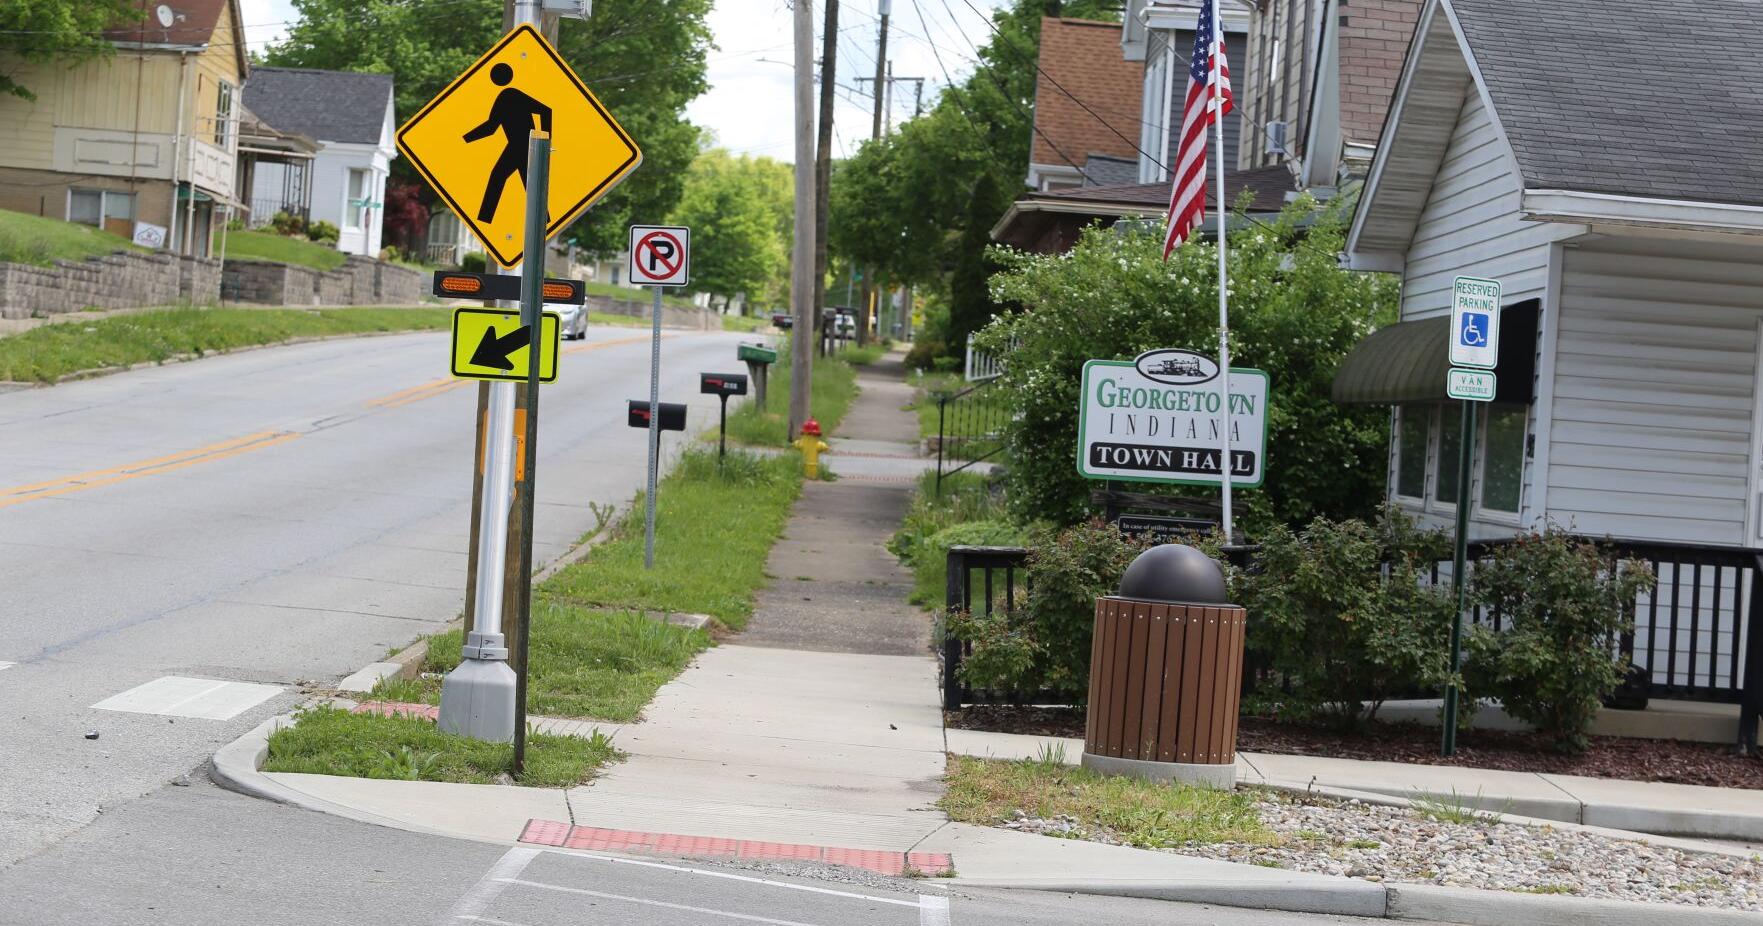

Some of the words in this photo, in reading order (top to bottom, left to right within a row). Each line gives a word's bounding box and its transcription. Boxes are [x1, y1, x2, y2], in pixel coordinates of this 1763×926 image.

[650, 240, 675, 271] P
[1457, 282, 1497, 297] RESERVED
[1459, 297, 1493, 311] PARKING
[1462, 376, 1482, 385] VAN
[1097, 378, 1256, 415] GEORGETOWN
[1109, 413, 1240, 441] INDIANA
[1097, 446, 1172, 468] TOWN
